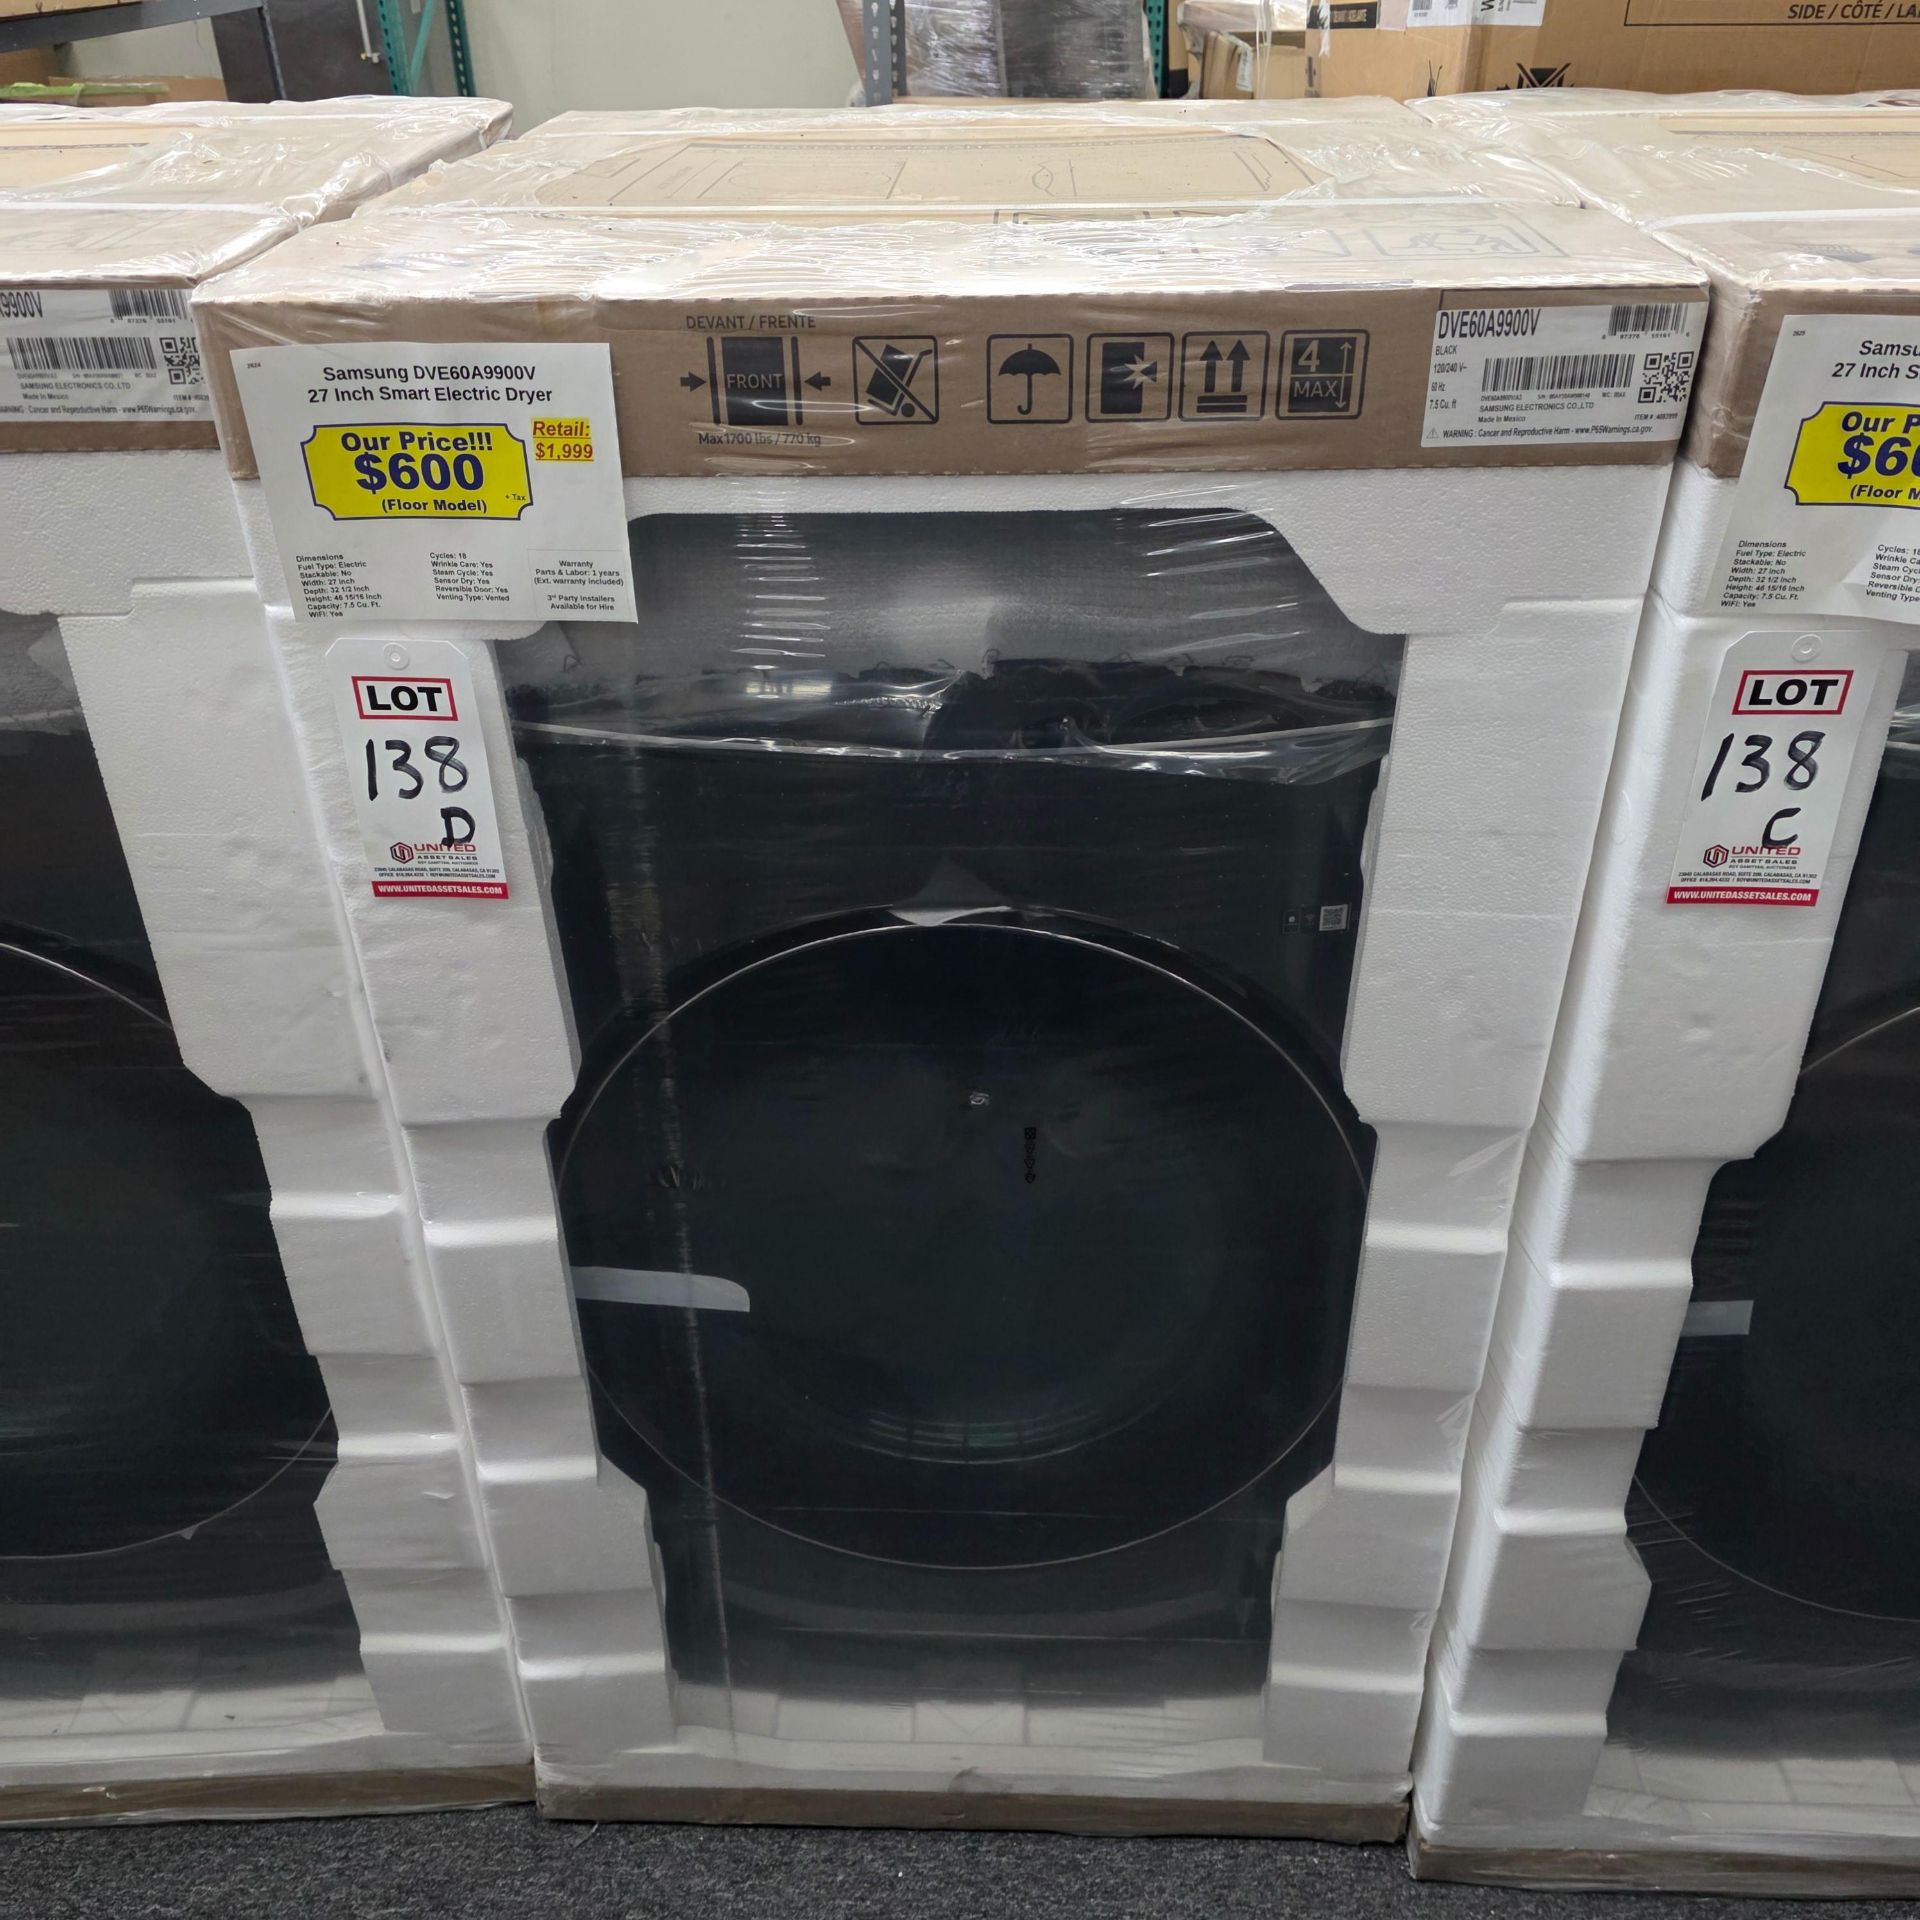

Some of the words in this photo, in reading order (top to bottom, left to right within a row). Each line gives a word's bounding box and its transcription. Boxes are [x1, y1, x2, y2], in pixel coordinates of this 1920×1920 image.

[1788, 4, 1826, 19] SIDE
[1840, 0, 1883, 19] CÔTÉ
[686, 315, 745, 329] DEVANT
[759, 315, 816, 328] FRENTE
[1438, 309, 1541, 339] DVE60A9900V
[1298, 340, 1320, 372] 4
[1435, 345, 1457, 356] BLACK
[1434, 363, 1457, 373] 120/240
[1832, 362, 1856, 378] 27
[1859, 363, 1900, 379] Inch
[323, 366, 408, 383] Samsung
[413, 365, 536, 380] DVE60A9900V
[20, 382, 54, 390] SAMSUNG
[55, 382, 103, 390] ELECTRONICS
[726, 373, 782, 389] FRONT
[1293, 380, 1338, 397] MAX
[308, 388, 328, 403] 27
[335, 386, 374, 401] Inch
[379, 386, 430, 401] Smart
[434, 386, 501, 401] Electric
[505, 387, 552, 405] Dryer
[61, 406, 100, 415] Reproductive
[1480, 404, 1514, 412] SAMSUNG
[1515, 402, 1565, 411] ELECTRONICS
[1841, 411, 1895, 433] Our
[532, 421, 591, 437] Retail:
[1443, 430, 1474, 438] WARNING
[1478, 429, 1499, 438] Cancer
[1500, 428, 1512, 436] and
[1513, 427, 1552, 437] Reproductive
[1553, 427, 1570, 435] Harm
[341, 432, 390, 451] Our
[399, 431, 493, 451] Price!!!
[698, 433, 723, 445] Max
[725, 433, 753, 445] 1700
[755, 433, 773, 445] lbs
[806, 433, 822, 447] kg
[535, 442, 593, 460] $1,999
[354, 452, 484, 494] $600
[512, 493, 526, 501] Tax
[1850, 484, 1902, 499] (Floor
[381, 498, 428, 513] (Floor
[434, 499, 487, 513] Model)
[1738, 540, 1787, 548] Dimensions
[1877, 544, 1909, 554] Cycles:
[296, 554, 344, 562] Dimensions
[430, 552, 456, 560] Cycles:
[1755, 550, 1775, 558] Type:
[1875, 553, 1907, 564] Wrinkle
[559, 560, 593, 568] Warranty
[1872, 562, 1899, 571] Steam
[300, 571, 339, 579] Stackable:
[456, 569, 479, 577] Cycle:
[1870, 572, 1901, 581] Sensor
[534, 577, 551, 585] (Ext.
[553, 578, 586, 586] warranty
[588, 578, 624, 586] included)
[1867, 581, 1913, 592] Reversible
[1725, 584, 1753, 592] Height:
[465, 594, 483, 602] Type:
[1723, 592, 1759, 600] Capacity:
[1866, 589, 1898, 601] Venting
[1748, 679, 1839, 706] LOT
[366, 685, 442, 712] LOT
[366, 736, 469, 801] 138
[1701, 730, 1826, 801] 138
[440, 806, 475, 848] D
[1761, 807, 1801, 849] C
[1731, 846, 1802, 856] UNITED
[378, 885, 503, 894] WWW.UNITEDASSETSALES.COM
